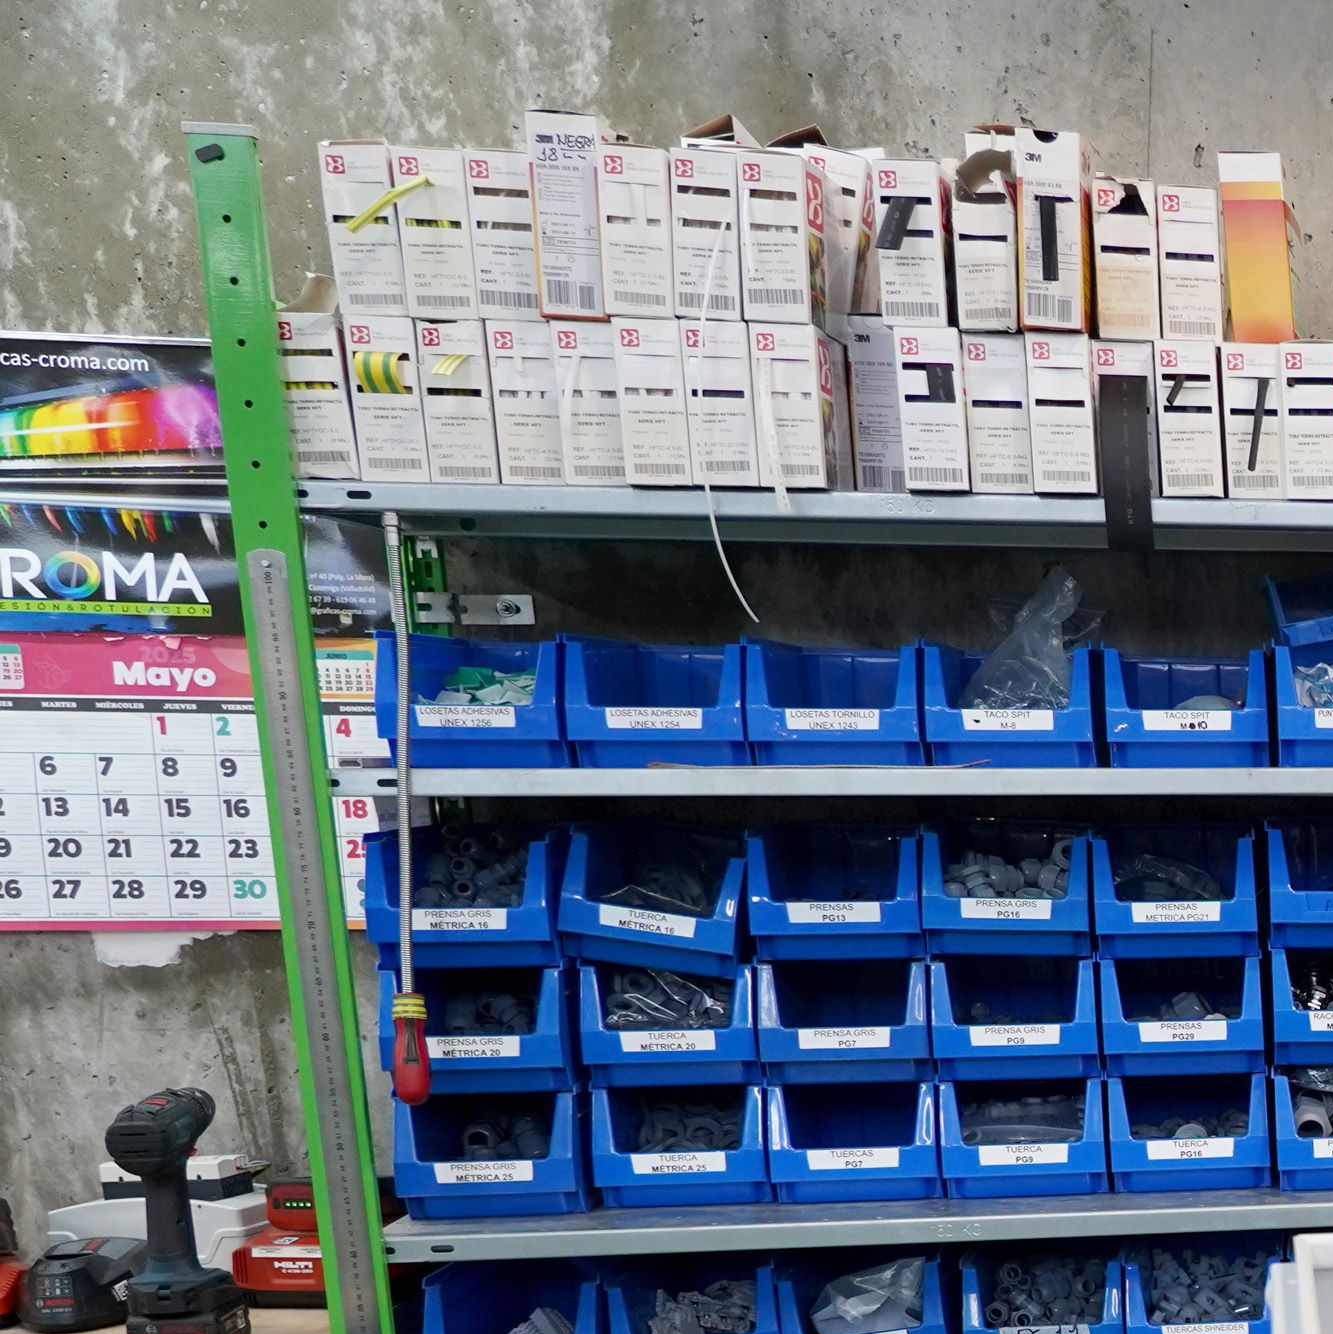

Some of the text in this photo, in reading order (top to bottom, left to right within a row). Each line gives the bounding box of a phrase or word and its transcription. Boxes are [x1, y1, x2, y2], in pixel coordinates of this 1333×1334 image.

[1024, 152, 1042, 162] 3M
[854, 334, 871, 343] 3M
[112, 661, 217, 692] Mayo
[41, 701, 77, 709] MARTES
[163, 703, 198, 711] JUEVES
[420, 706, 511, 717] LOSETAS ADHESIVAS
[610, 709, 698, 719] LOSETAS ADHESIVAS
[790, 710, 875, 719] LOSETAS TORNILLO
[984, 710, 1031, 719] TACO SPIT
[156, 716, 167, 735] 1
[215, 716, 231, 736] 2
[336, 718, 352, 737] 4
[440, 718, 492, 727] UNEX 1256
[629, 720, 681, 729] UNEX 1254
[808, 721, 858, 730] UNEX 1243
[39, 755, 57, 776] 6
[98, 756, 114, 776] 7
[162, 757, 179, 777] 8
[220, 757, 237, 777] 9
[41, 797, 70, 817] 13
[102, 797, 130, 817] 14
[164, 798, 191, 818] 15
[223, 799, 250, 818] 16
[342, 799, 368, 819] 18
[47, 838, 82, 858] 20
[107, 838, 132, 858] 21
[170, 838, 200, 858] 22
[228, 839, 259, 859] 23
[52, 879, 81, 899] 27
[111, 879, 145, 899] 28
[174, 879, 207, 899] 29
[233, 879, 267, 899] 30
[809, 903, 854, 911] PRENSAS
[976, 899, 1038, 908] PRENSA GRIS
[1155, 903, 1198, 911] PRENSAS
[424, 910, 492, 919] PRENSA GRIS
[629, 910, 668, 922] TUERCA
[822, 914, 846, 922] PG13
[997, 910, 1021, 919] PG16
[1188, 913, 1209, 921] PG21
[478, 921, 489, 930] 16
[664, 926, 675, 935] 16
[985, 1026, 1046, 1035] PRENSA GRIS
[1160, 1022, 1202, 1030] PRENSAS
[1007, 1037, 1025, 1045] PG9
[1172, 1033, 1195, 1041] PG29
[831, 1150, 874, 1158] TUERCAS
[845, 1160, 863, 1168] PG7
[1166, 1323, 1244, 1334] TUERCAS SHNEIDER
